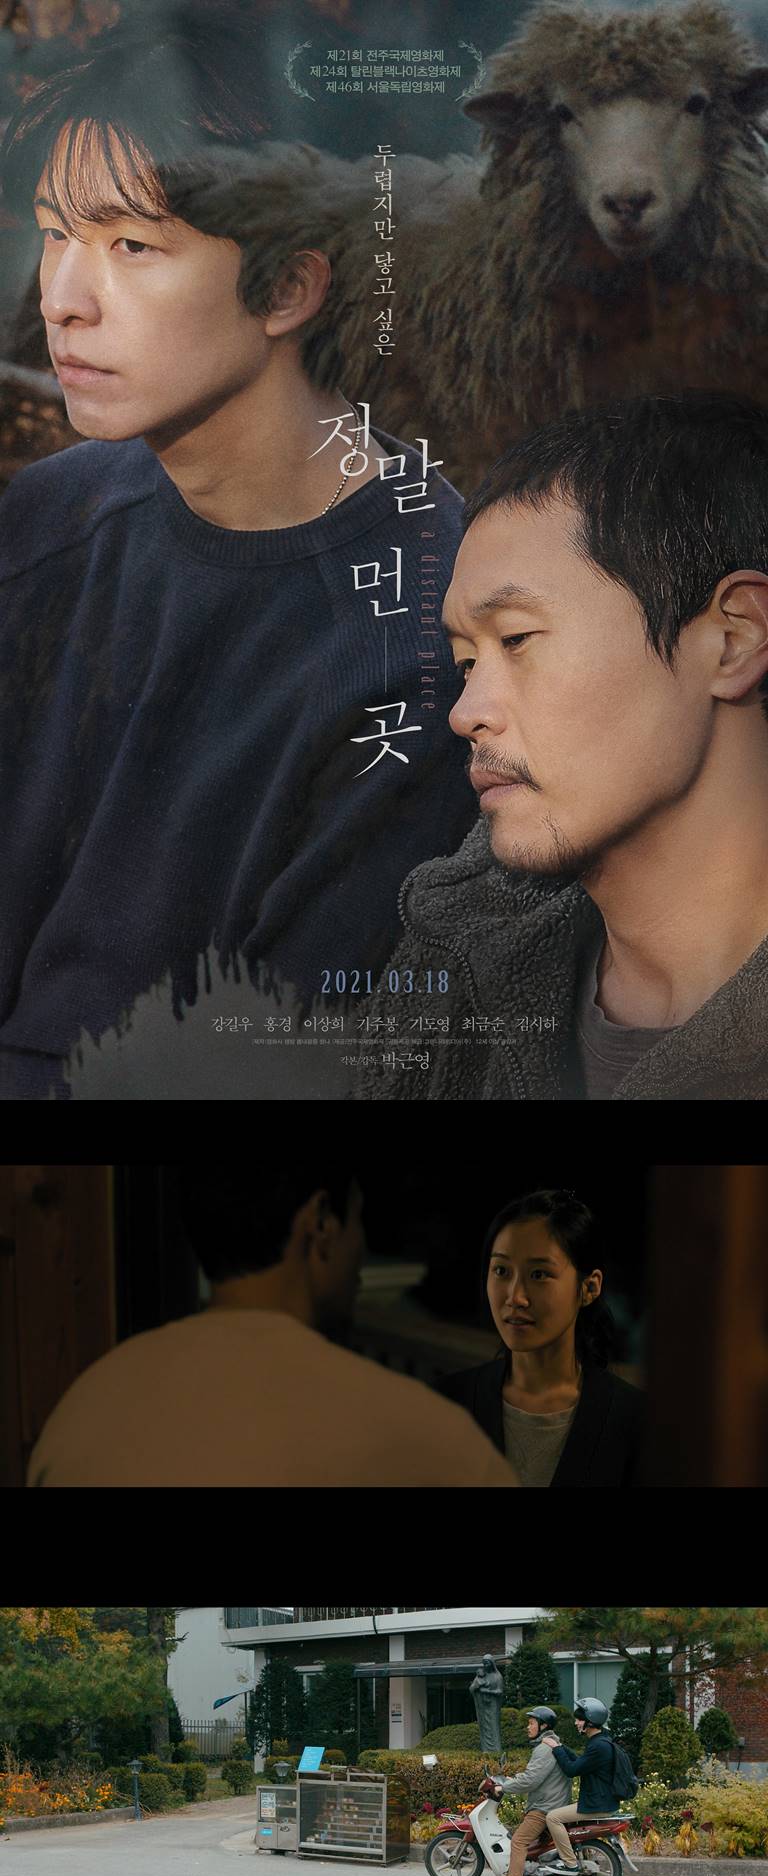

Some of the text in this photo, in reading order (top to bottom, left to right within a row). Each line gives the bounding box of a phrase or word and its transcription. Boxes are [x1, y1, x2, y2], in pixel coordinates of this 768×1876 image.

[327, 49, 444, 62] 제21회 전주국제영화제
[310, 65, 461, 78] 제24회 탈린블랙나이츠영화제
[326, 81, 445, 94] 제46회 서울독립영화제
[373, 144, 396, 356] 두렵지만 닿고 싶은
[305, 402, 444, 778] 정말 먼 곳
[420, 555, 440, 634] distant
[418, 652, 440, 709] place
[320, 969, 449, 994] 2021.03.18
[210, 1016, 559, 1032] 강길우 홍경 이상희 기주봉 기도영 최금순 김시하
[381, 1051, 430, 1070] 박근영
